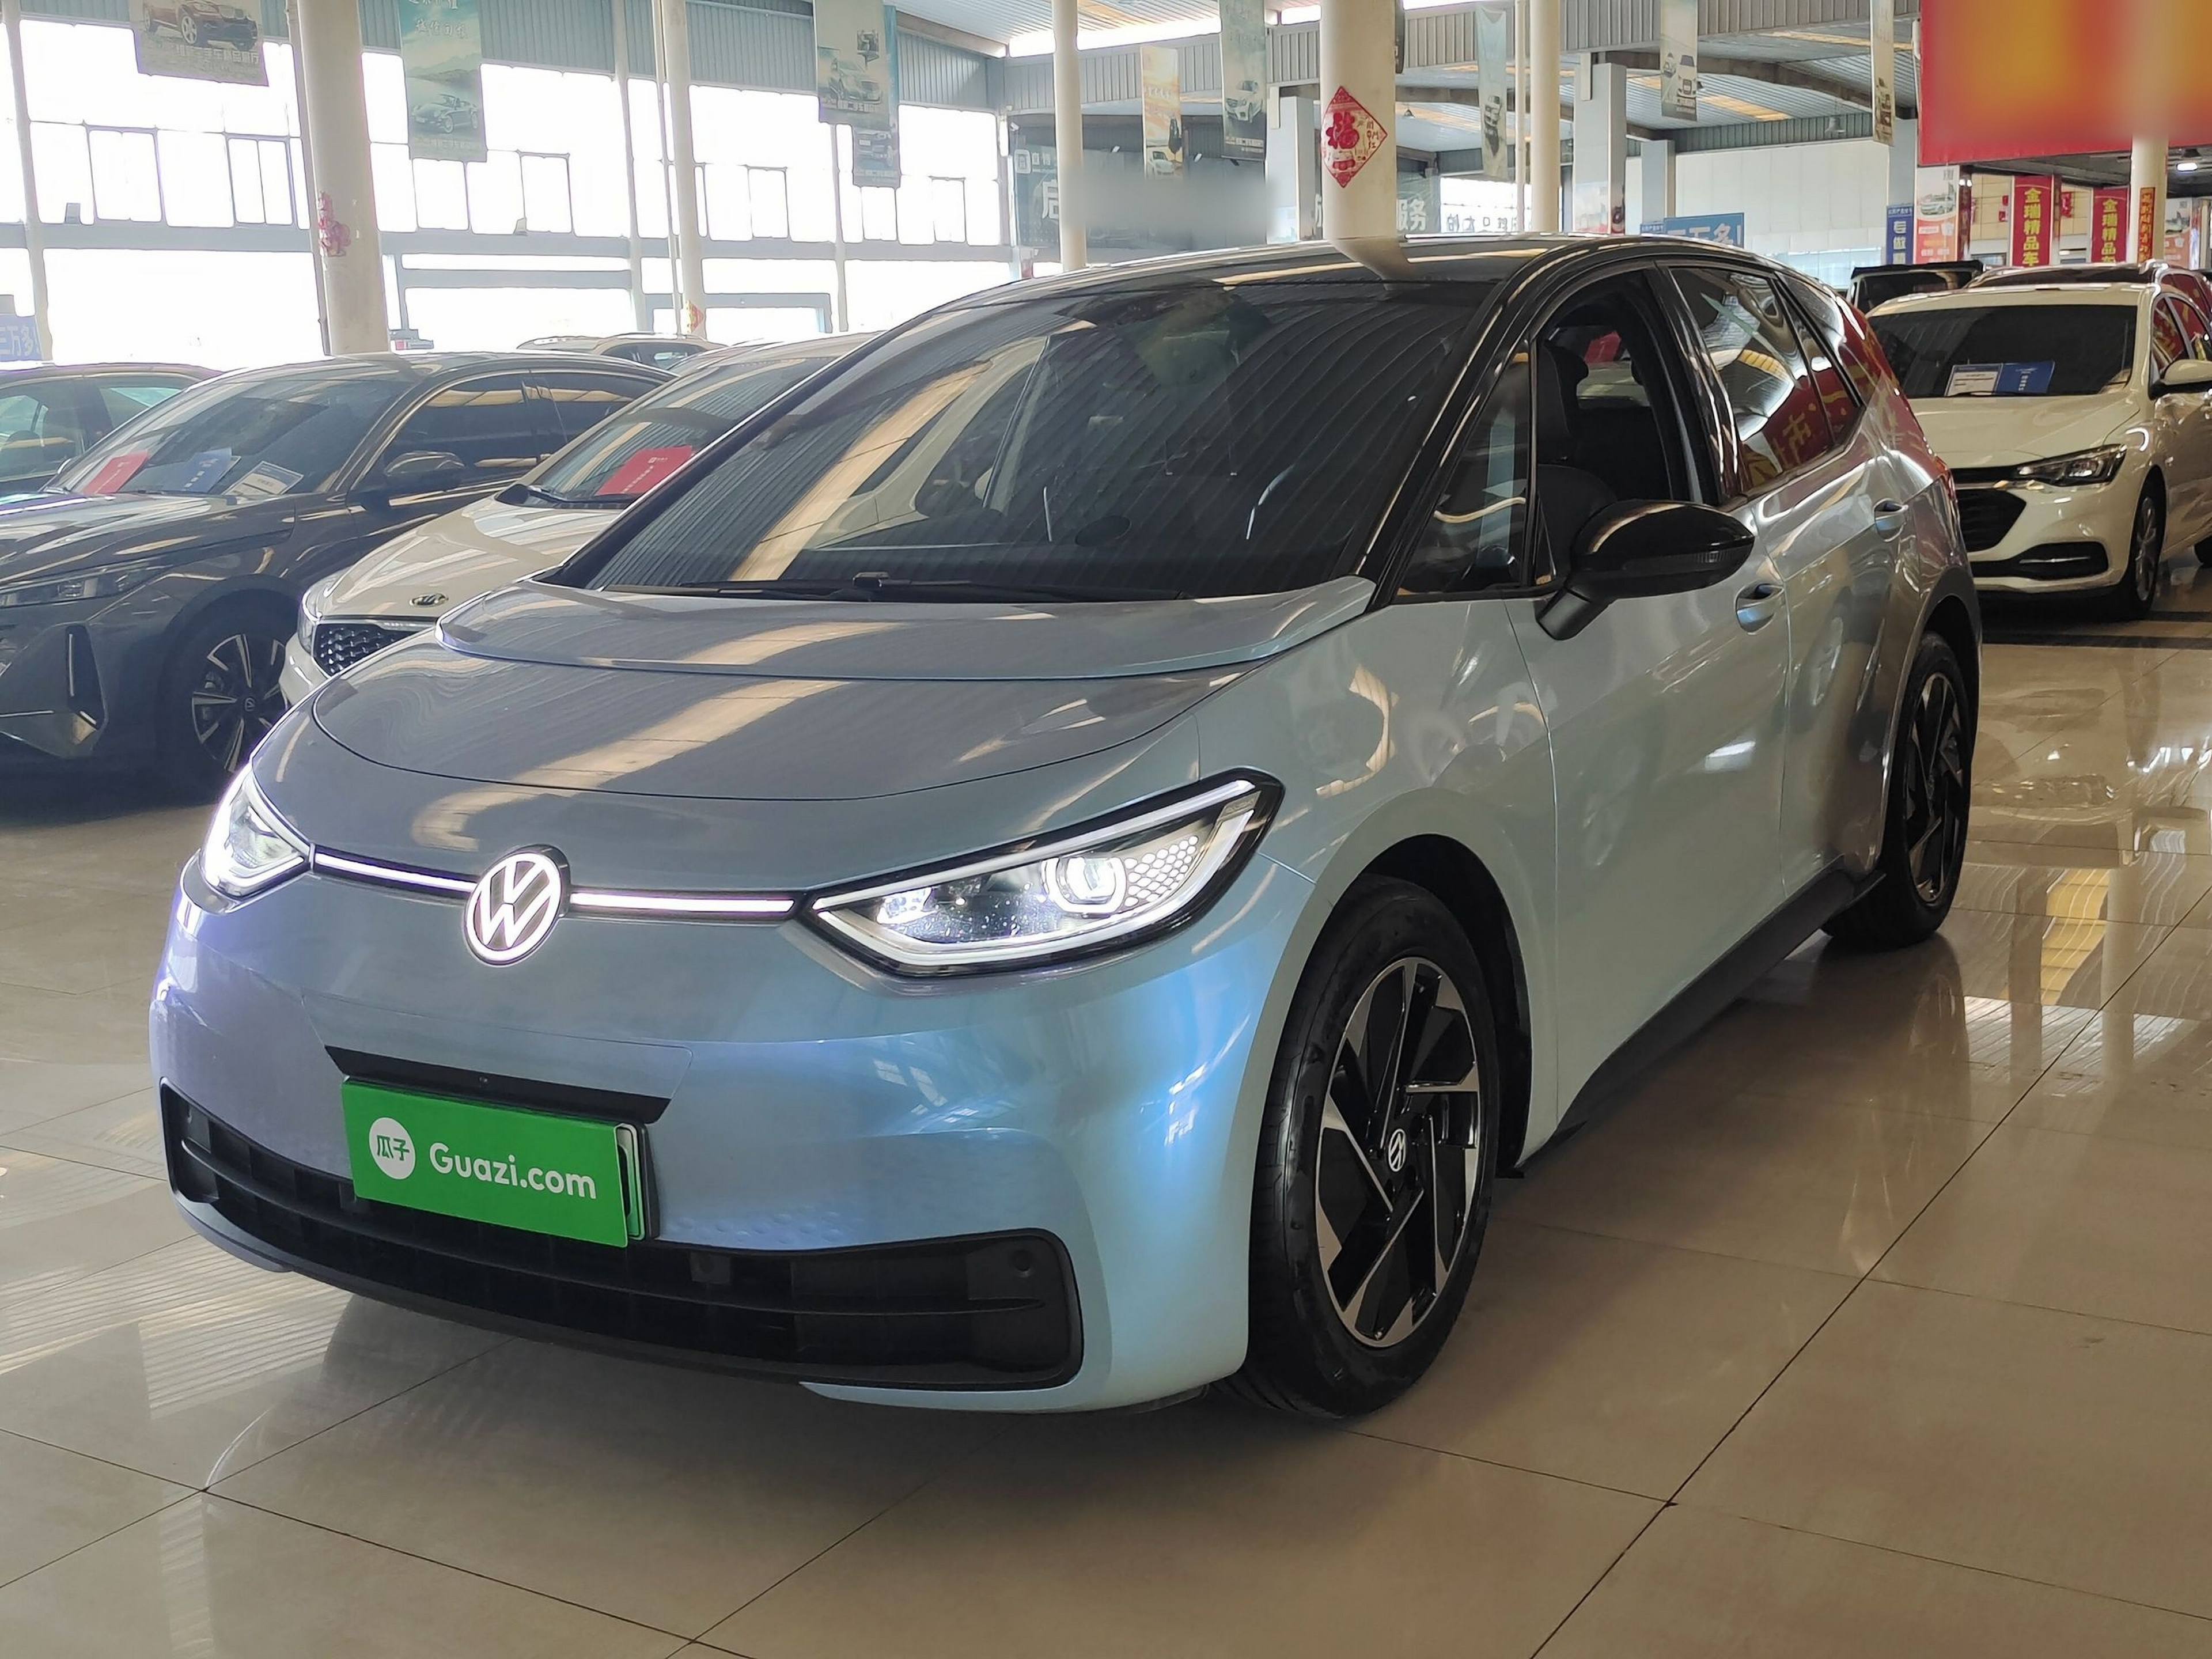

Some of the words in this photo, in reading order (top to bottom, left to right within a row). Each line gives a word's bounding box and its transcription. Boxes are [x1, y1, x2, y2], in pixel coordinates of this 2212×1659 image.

[1325, 111, 1360, 149] 福
[2022, 188, 2041, 267] 金瑞精品车
[377, 1134, 410, 1161] 瓜子
[429, 1142, 596, 1199] Guazi.com
